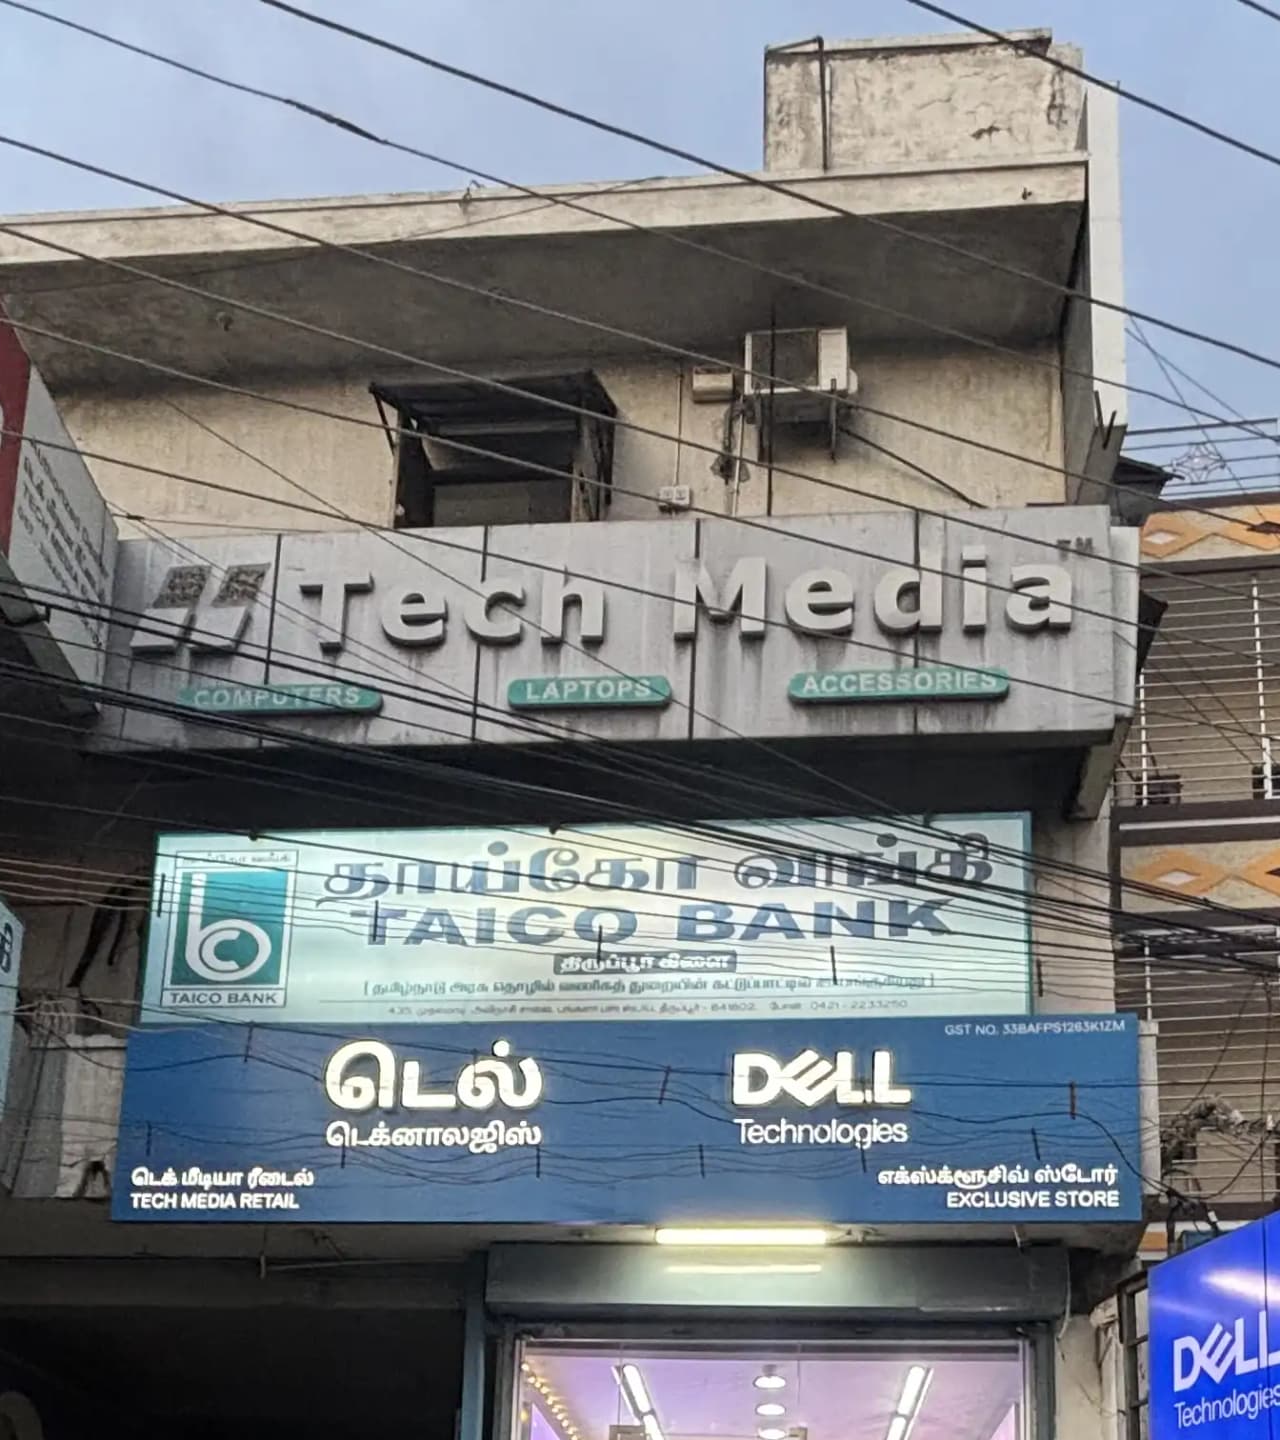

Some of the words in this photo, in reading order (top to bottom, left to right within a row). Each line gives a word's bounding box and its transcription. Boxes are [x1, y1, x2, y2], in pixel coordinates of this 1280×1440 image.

[299, 570, 605, 652] Tech
[672, 544, 1073, 640] Media
[194, 684, 360, 708] COMPUTERS
[526, 675, 651, 702] LAPTOPS
[802, 672, 997, 696] ACCESSORIES
[316, 840, 698, 907] தாய்கோ
[349, 906, 638, 946] TAICO
[676, 899, 955, 941] BANK
[171, 992, 223, 1004] TAICO
[228, 992, 277, 1003] BANK
[945, 1023, 973, 1036] GST
[976, 1023, 999, 1036] NO.
[325, 1038, 544, 1110] டெல்
[732, 1049, 912, 1106] DELL
[734, 1118, 908, 1149] Technologies
[131, 1194, 178, 1208] TECH
[181, 1193, 236, 1208] MEDIA
[240, 1193, 300, 1208] RETAIL
[946, 1191, 1050, 1208] EXCLUSIVE
[1055, 1190, 1119, 1207] STORE
